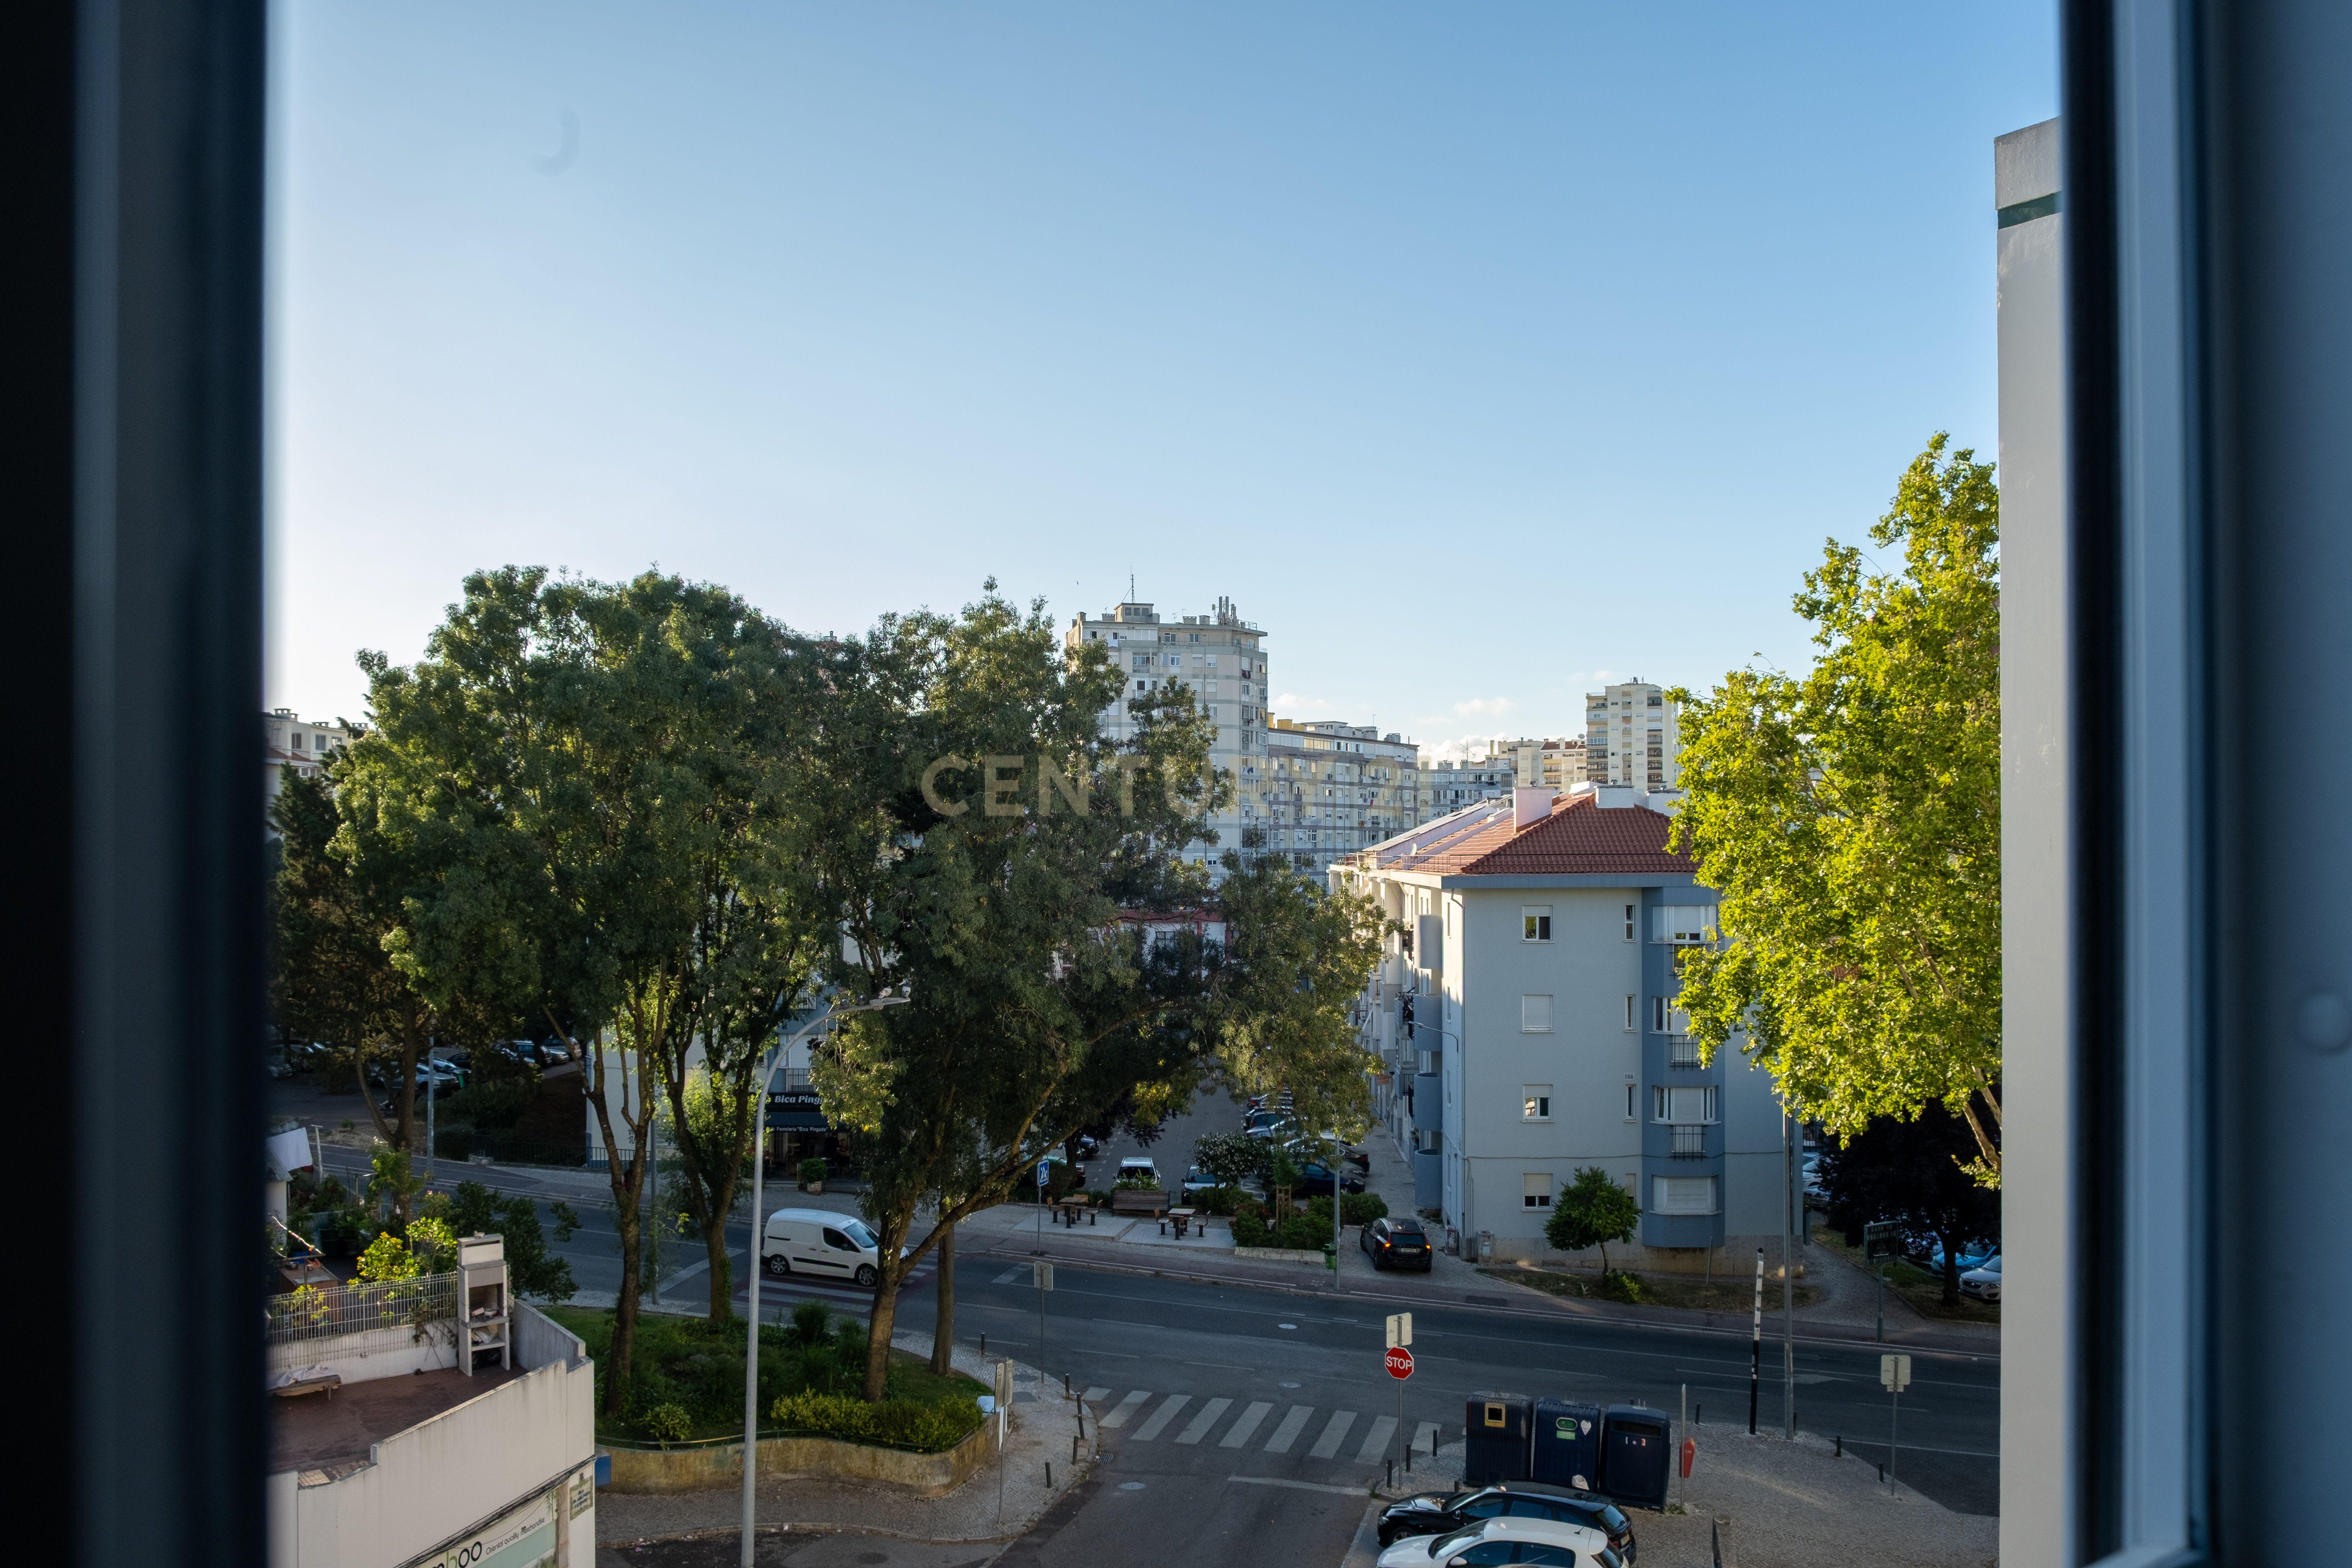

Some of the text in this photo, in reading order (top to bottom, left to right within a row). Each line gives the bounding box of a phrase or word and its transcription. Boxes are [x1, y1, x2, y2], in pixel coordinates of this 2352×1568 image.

[1386, 1356, 1412, 1370] STOP
[486, 1539, 503, 1554] Oriental
[504, 1532, 519, 1545] quality
